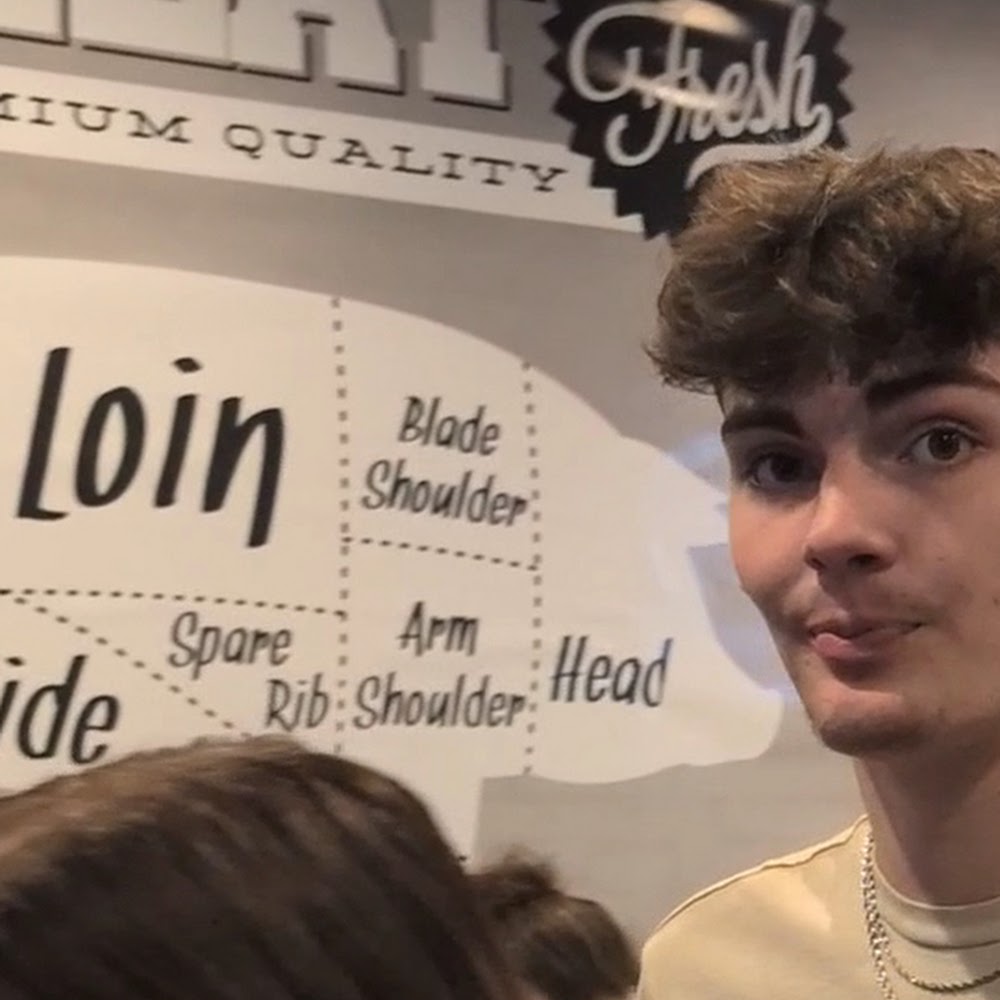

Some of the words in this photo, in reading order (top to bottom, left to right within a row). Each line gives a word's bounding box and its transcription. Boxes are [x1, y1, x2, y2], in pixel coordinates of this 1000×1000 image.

[568, 0, 833, 170] Fresh
[223, 122, 568, 193] QUALITY
[15, 345, 286, 549] Loin
[397, 395, 502, 456] Blade
[359, 458, 529, 528] Shoulder
[167, 610, 293, 681] Spare
[396, 599, 480, 657] Arm
[264, 672, 331, 732] Rib
[351, 671, 528, 730] Shoulder
[549, 634, 676, 708] Head
